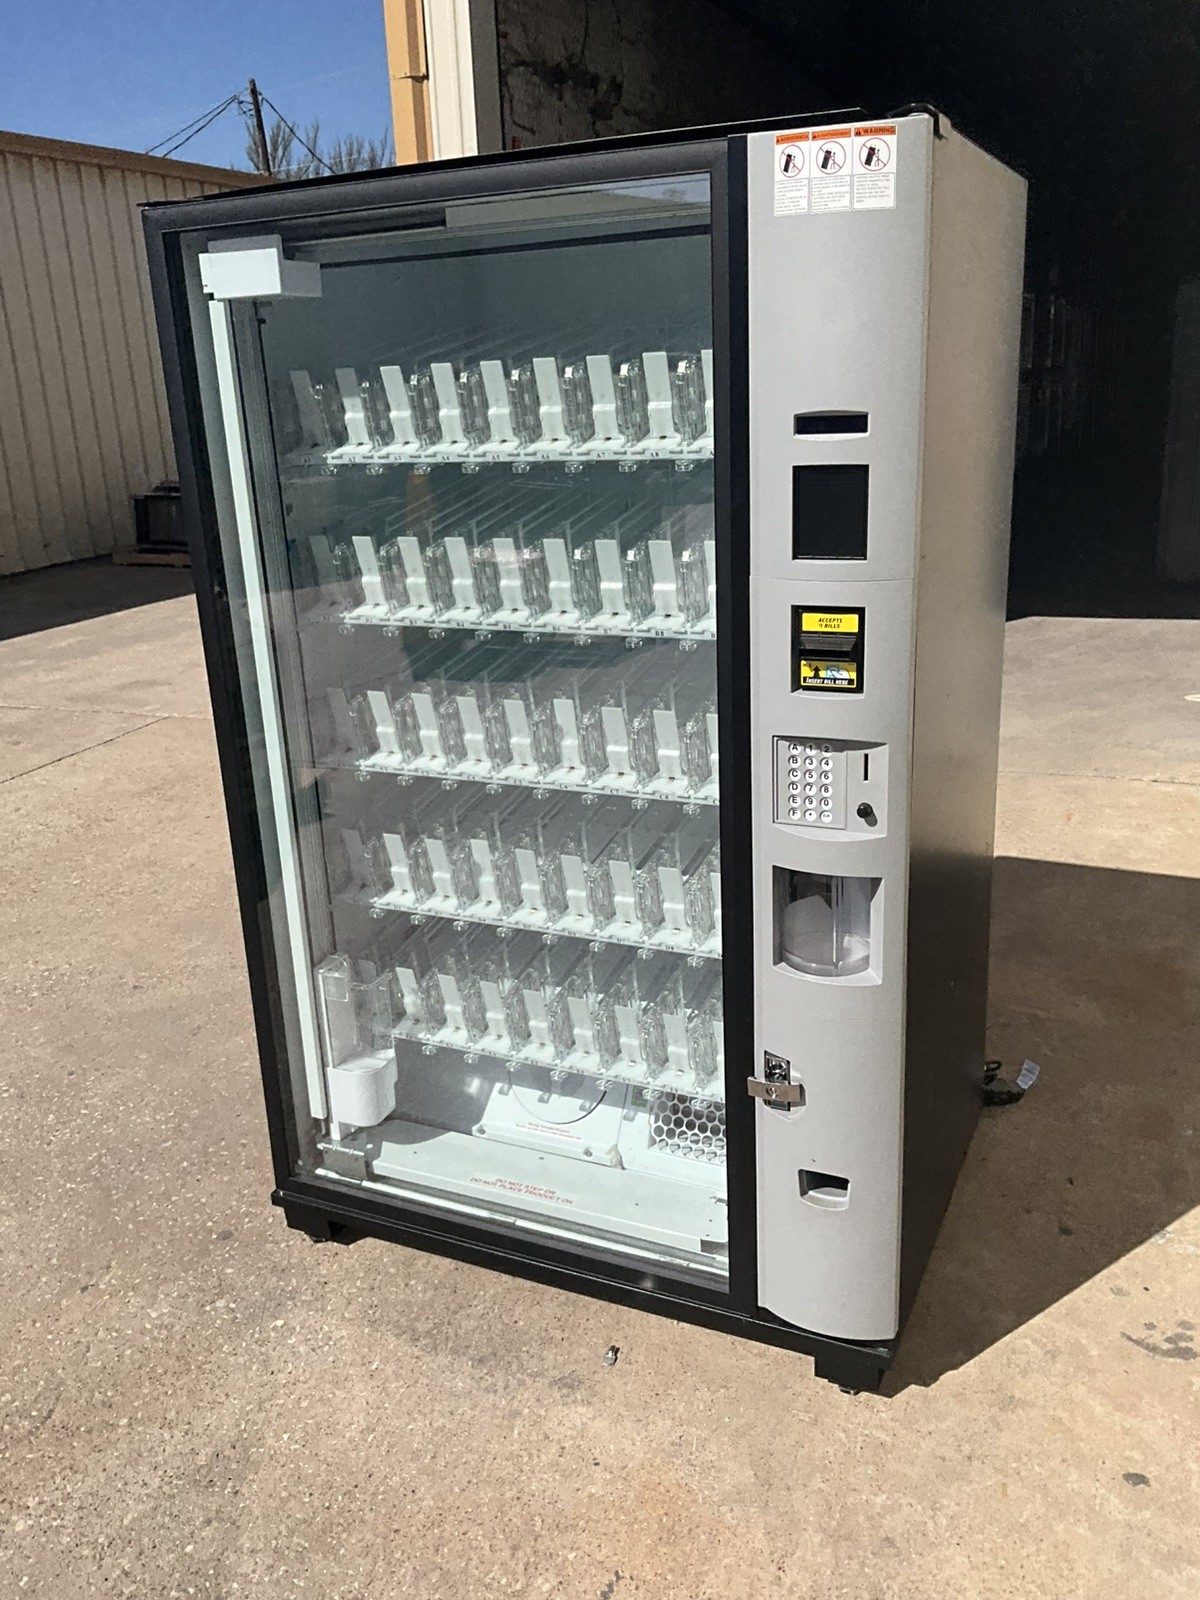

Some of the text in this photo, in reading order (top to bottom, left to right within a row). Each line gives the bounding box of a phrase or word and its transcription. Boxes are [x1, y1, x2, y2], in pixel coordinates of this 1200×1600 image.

[863, 126, 896, 135] WARNING
[805, 677, 824, 685] INSERT
[792, 743, 830, 753] A 1 2
[792, 756, 830, 767] B 3 4
[791, 769, 830, 780] C 5 6
[808, 784, 814, 792] 7
[823, 785, 830, 793] 8
[792, 796, 829, 807] E 9 0
[792, 809, 798, 817] F
[524, 1184, 544, 1192] STEP
[499, 1184, 523, 1193] PLACE
[524, 1189, 561, 1202] PRODUCT
